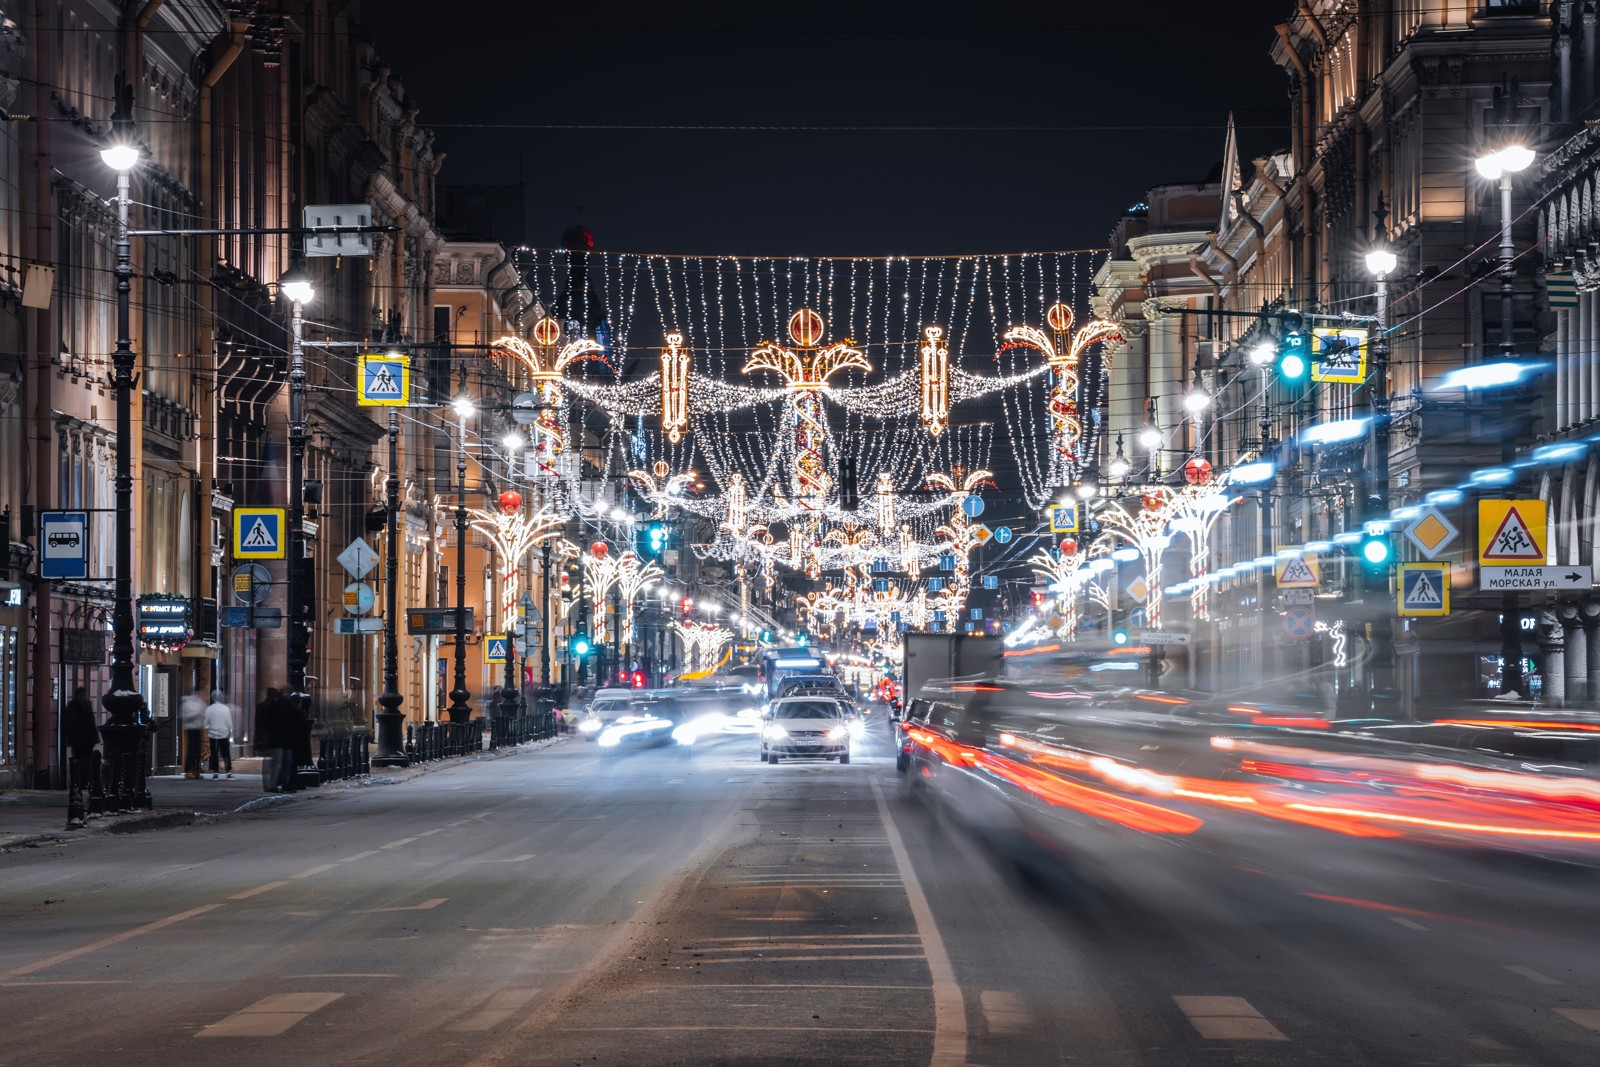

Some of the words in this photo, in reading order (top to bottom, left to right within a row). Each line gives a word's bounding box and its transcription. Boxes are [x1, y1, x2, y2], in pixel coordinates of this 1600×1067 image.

[1504, 568, 1543, 577] МАЛАЯ
[1489, 578, 1541, 588] МОРСКАЯ
[1543, 580, 1558, 589] ул.
